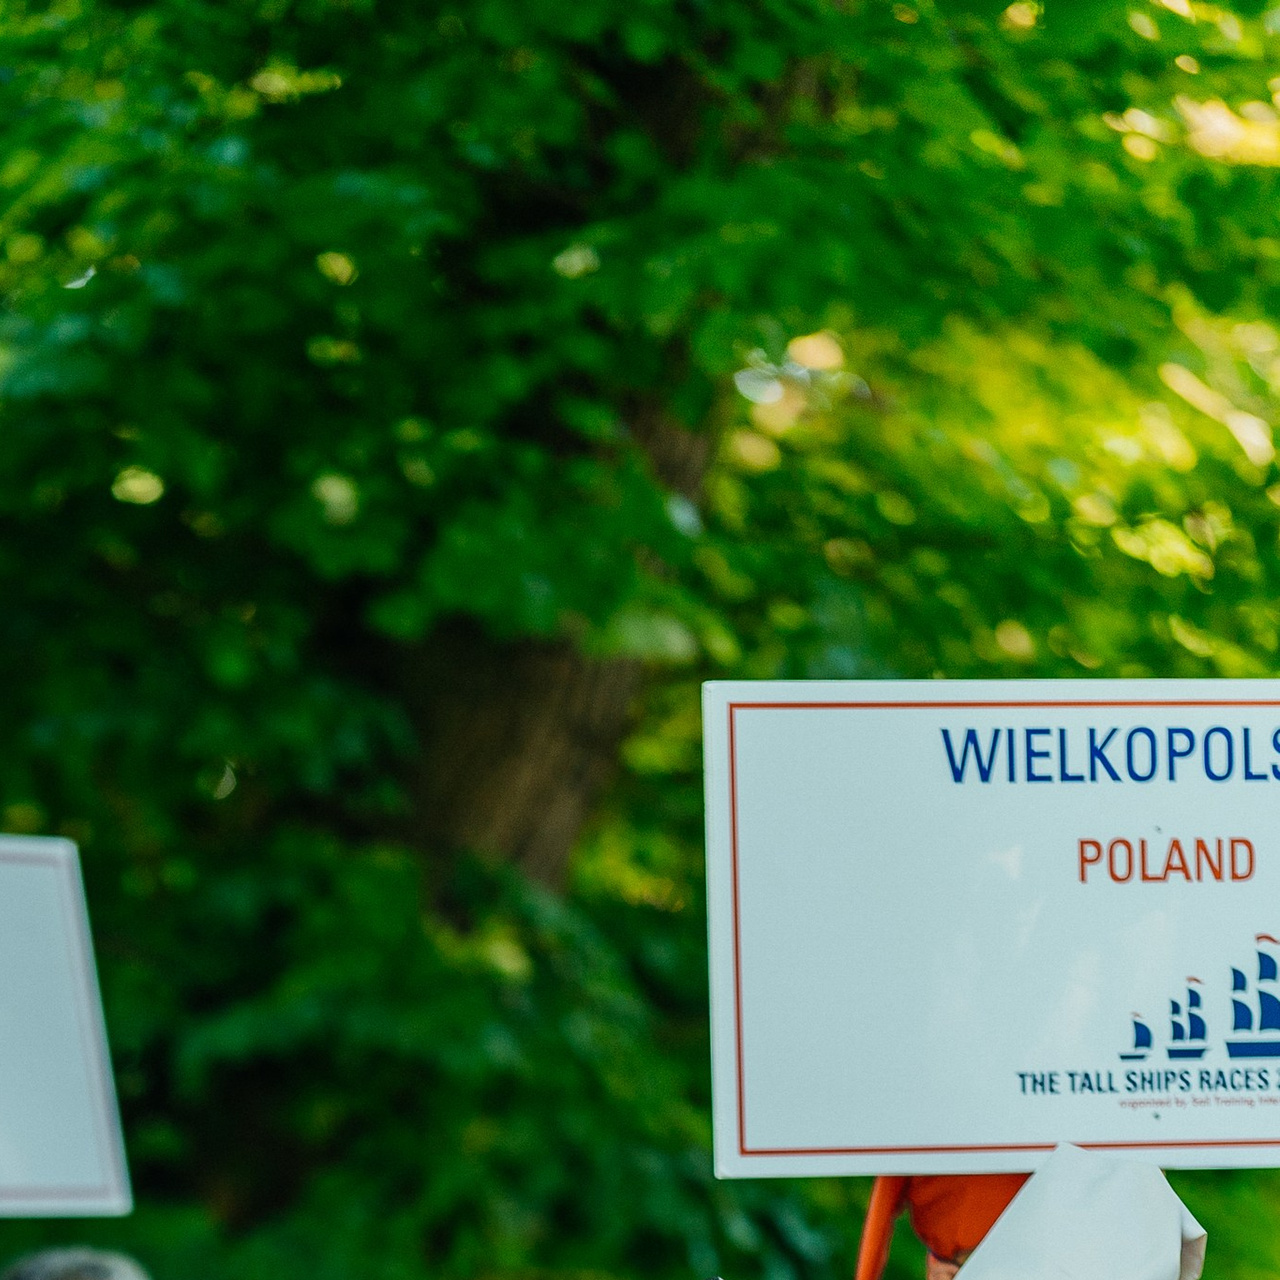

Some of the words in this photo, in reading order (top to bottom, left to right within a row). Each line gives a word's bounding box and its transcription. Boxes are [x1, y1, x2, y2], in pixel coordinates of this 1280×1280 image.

[940, 726, 1280, 783] WIELKOPOL
[1078, 838, 1256, 882] POLAND
[1019, 1072, 1059, 1094] THE
[1069, 1071, 1119, 1093] TALL
[1126, 1070, 1191, 1092] SHIPS
[1200, 1069, 1269, 1091] RACES
